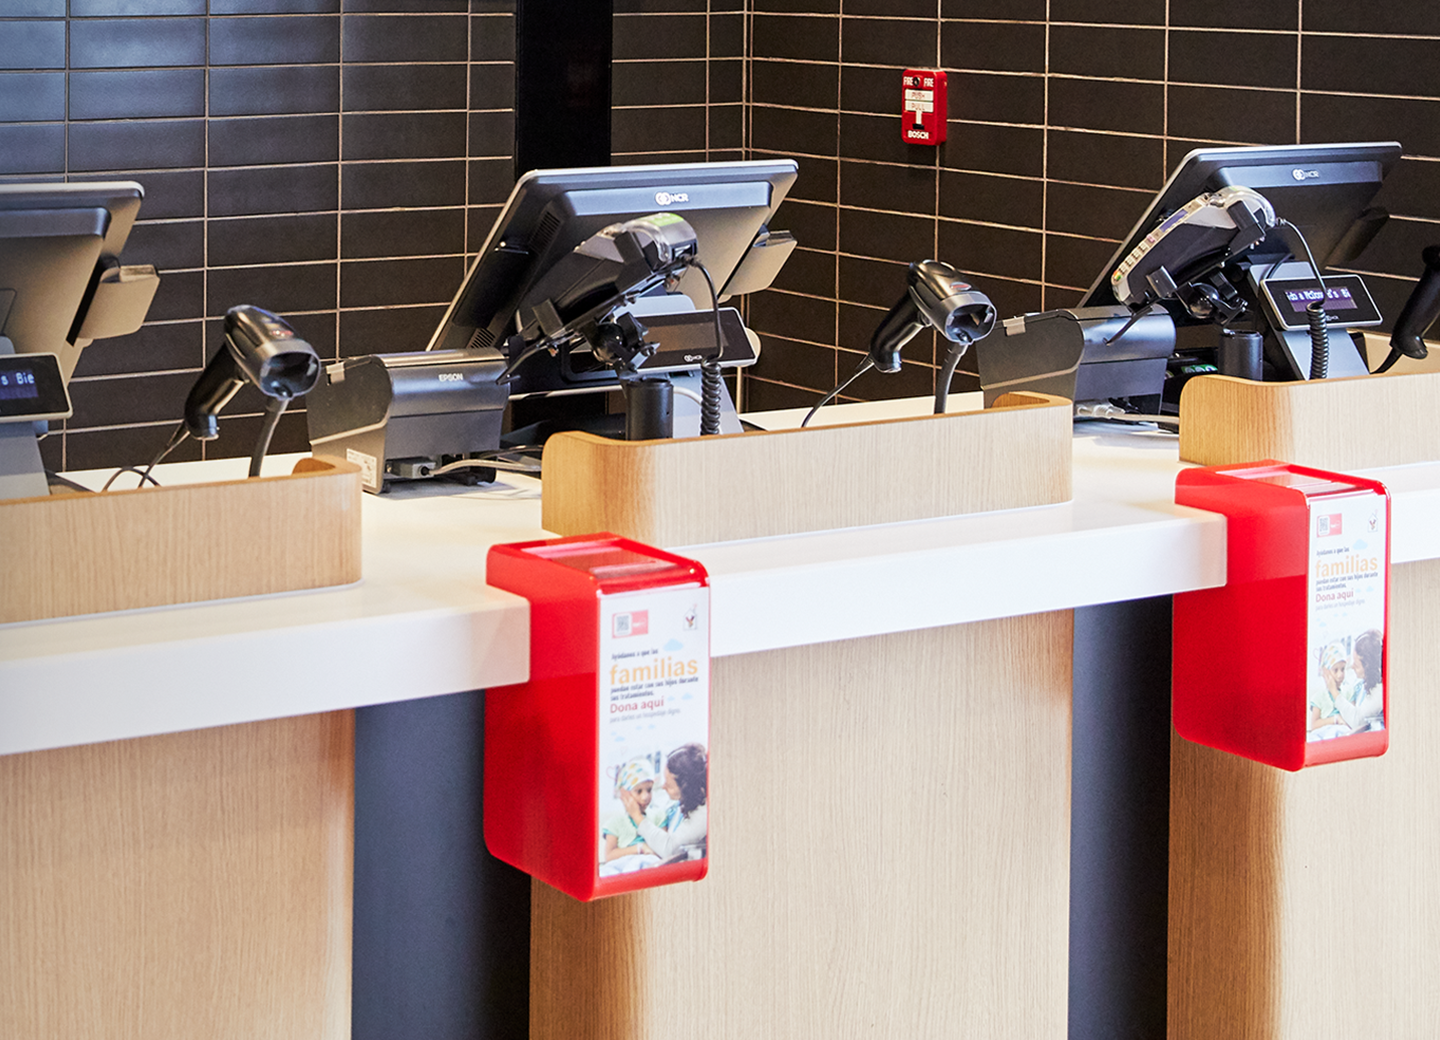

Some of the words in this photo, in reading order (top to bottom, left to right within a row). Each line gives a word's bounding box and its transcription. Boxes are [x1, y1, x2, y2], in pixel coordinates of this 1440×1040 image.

[911, 102, 925, 111] PULL
[908, 130, 929, 139] BOSCH
[15, 372, 35, 385] Bie
[439, 373, 463, 382] EPSON
[1316, 554, 1378, 578] familias
[1316, 593, 1335, 603] Dona
[609, 656, 698, 685] familias
[610, 702, 638, 714] Dona
